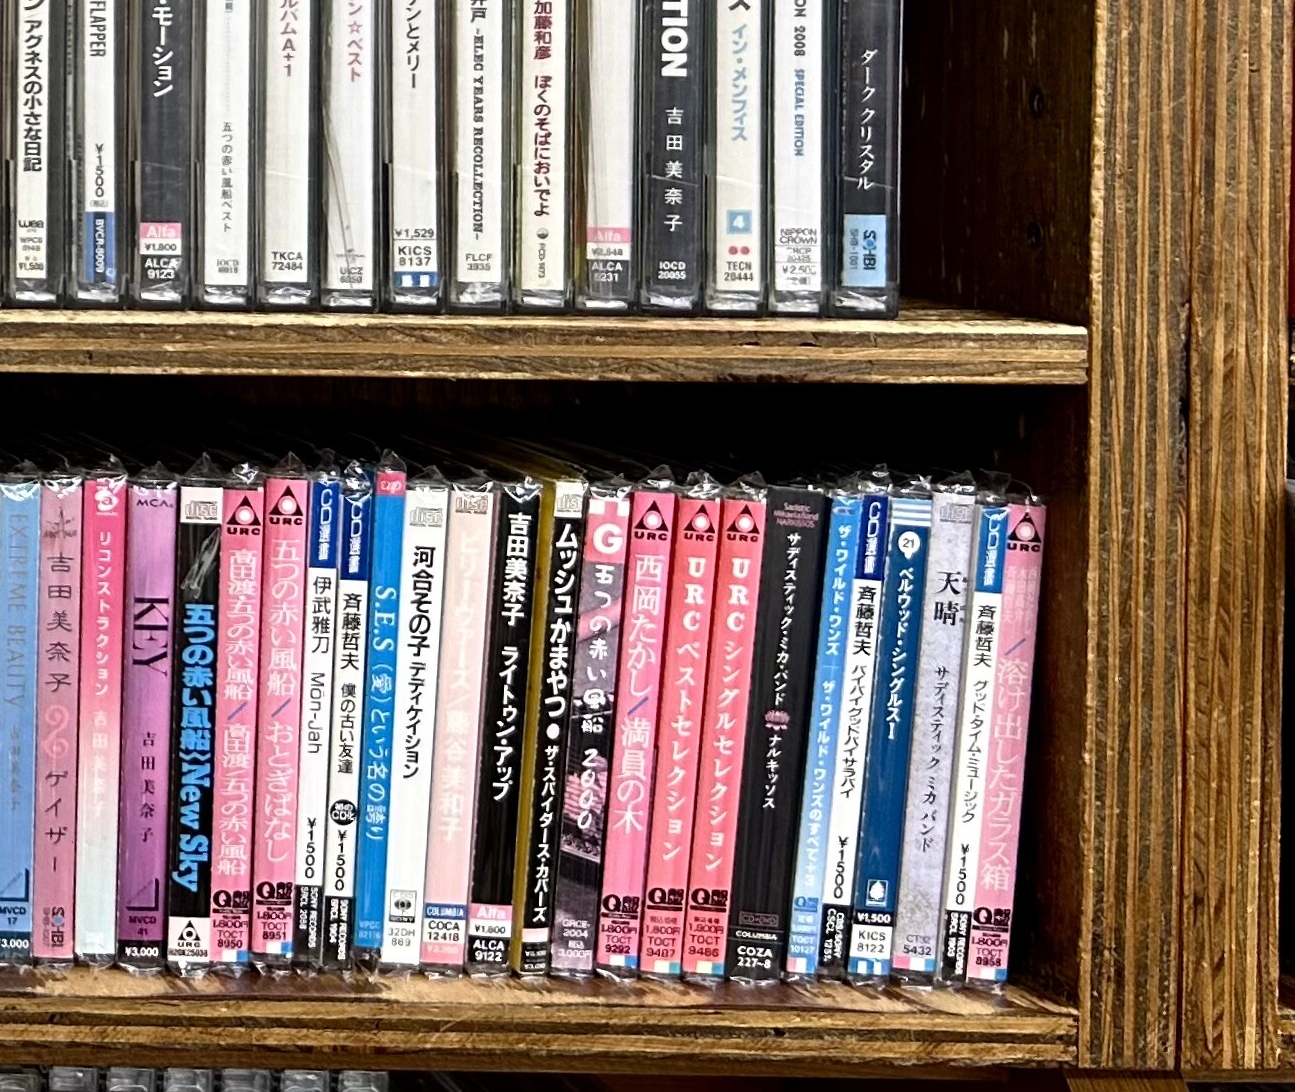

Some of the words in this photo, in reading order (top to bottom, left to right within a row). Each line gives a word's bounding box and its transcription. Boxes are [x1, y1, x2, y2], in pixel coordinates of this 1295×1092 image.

[89, 0, 106, 58] FLAPPER
[533, 0, 552, 60] 加藤和彦
[794, 26, 806, 57] 2008
[793, 110, 805, 156] EDITION
[794, 68, 806, 107] SPECIAL
[533, 75, 552, 217] ぼくのそばにおいでよ
[663, 107, 684, 232] 吉田美奈子
[133, 597, 169, 676] KEY
[406, 546, 434, 656] 河合その子
[543, 524, 578, 718] ムッシュかまやつ
[625, 554, 661, 699] 西岡たかし
[725, 559, 750, 633] URC
[772, 532, 800, 706] サディスティック・ミカ・バンド
[337, 682, 354, 775] 僕の古い友達
[401, 660, 426, 780] デディケイション
[611, 718, 651, 834] 満員の木
[704, 641, 738, 872] シングルセレクション
[763, 735, 780, 808] ナルキッソス
[979, 658, 1028, 891] 溶け出したガラス箱
[265, 721, 296, 864] おとぎばなし
